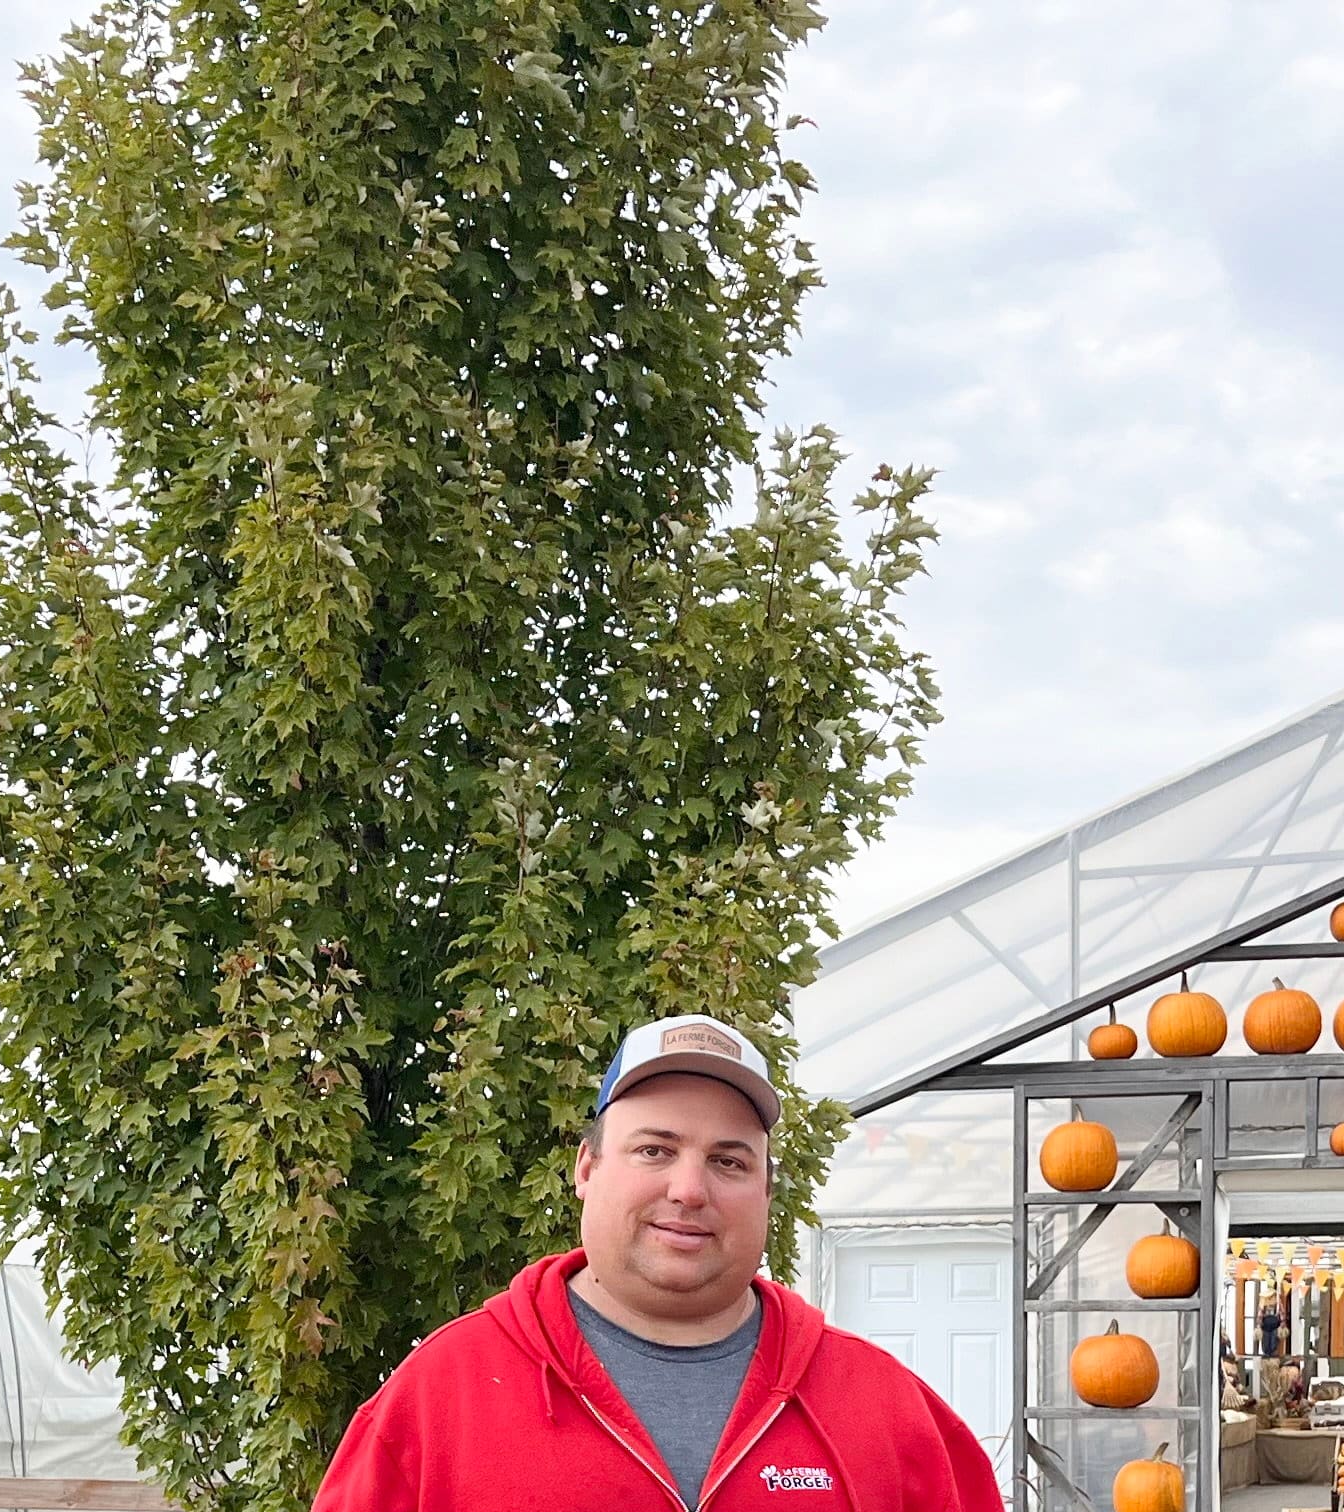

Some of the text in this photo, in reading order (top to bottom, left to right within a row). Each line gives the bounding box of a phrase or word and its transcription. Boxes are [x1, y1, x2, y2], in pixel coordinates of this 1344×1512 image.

[666, 1032, 736, 1056] LA FERME FORGET
[792, 1467, 828, 1476] FERME
[767, 1473, 831, 1490] FORGET
